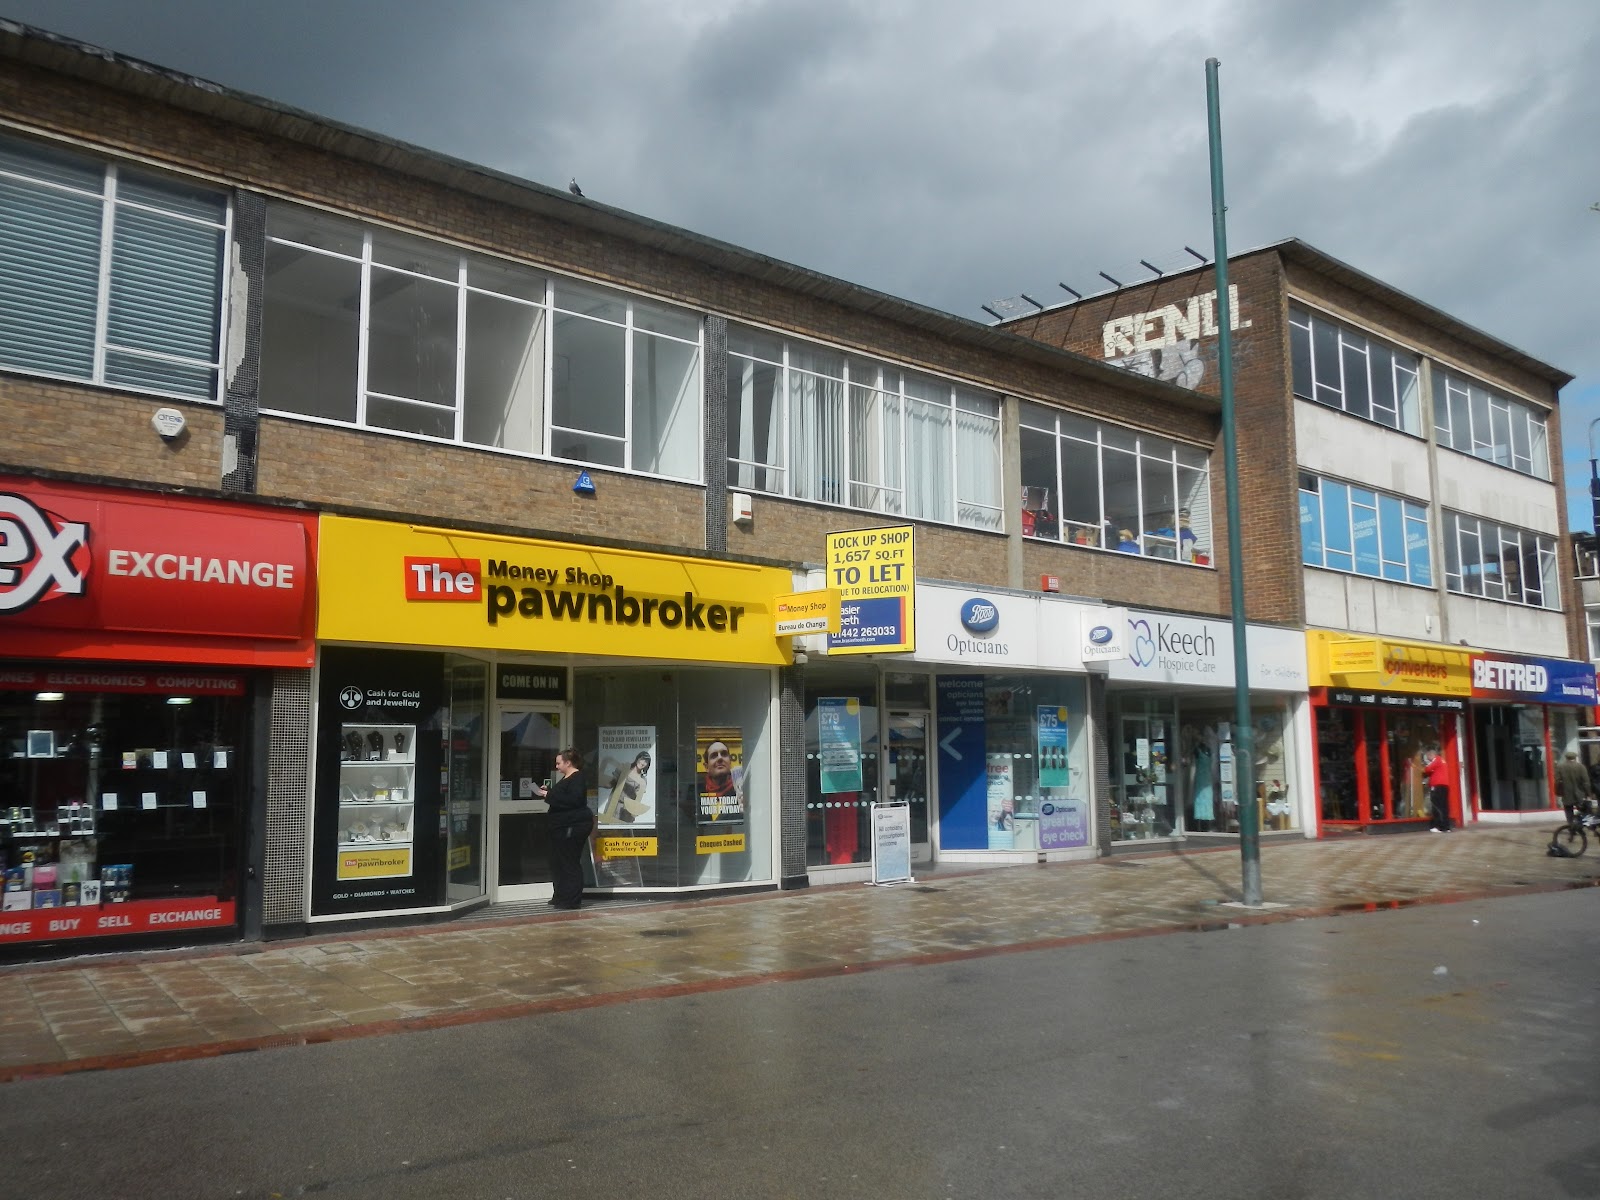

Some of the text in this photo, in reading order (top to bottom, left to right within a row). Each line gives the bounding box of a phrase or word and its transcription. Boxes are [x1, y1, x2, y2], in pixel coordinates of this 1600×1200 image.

[833, 531, 910, 550] LOCK UP SHOP
[834, 548, 905, 564] 1,657 SQ.FT
[108, 549, 294, 589] EXCHANGE
[411, 559, 614, 594] The Money Shop
[833, 563, 905, 586] TO LET
[851, 587, 860, 596] TO
[862, 583, 910, 595] RELOCATION)
[487, 583, 745, 632] pawnbroker
[787, 604, 809, 613] Money
[810, 602, 827, 611] Shop
[968, 604, 995, 624] Boots
[805, 621, 826, 629] Change
[860, 625, 896, 637] 263033
[947, 633, 1009, 656] Opticians
[1157, 622, 1215, 657] Keech
[1084, 645, 1121, 656] Opticians
[1158, 655, 1216, 674] Hospice Care
[1386, 660, 1448, 679] converters
[47, 672, 147, 688] ELECTRONICS
[156, 675, 237, 690] COMPUTING
[502, 674, 559, 689] COME ON IN
[1473, 659, 1548, 693] BETFRED
[938, 680, 984, 688] welcome
[367, 689, 420, 699] Cash for Gold
[946, 690, 984, 699] opticians
[366, 698, 421, 709] and Jewellery
[821, 712, 840, 725] £79
[1039, 713, 1058, 728] £75
[987, 763, 1009, 774] free
[700, 797, 718, 806] MAKE
[719, 795, 738, 805] TODAY
[700, 805, 740, 815] YOUR PAYDAY
[699, 838, 743, 849] Cheques Cashed
[1042, 830, 1085, 845] eye check
[357, 858, 405, 869] pawnbroker
[332, 892, 349, 900] GOLD
[353, 890, 385, 898] DIAMONDS
[48, 918, 81, 932] BUY
[98, 914, 132, 928] SELL
[149, 908, 222, 925] EXCHANGE
